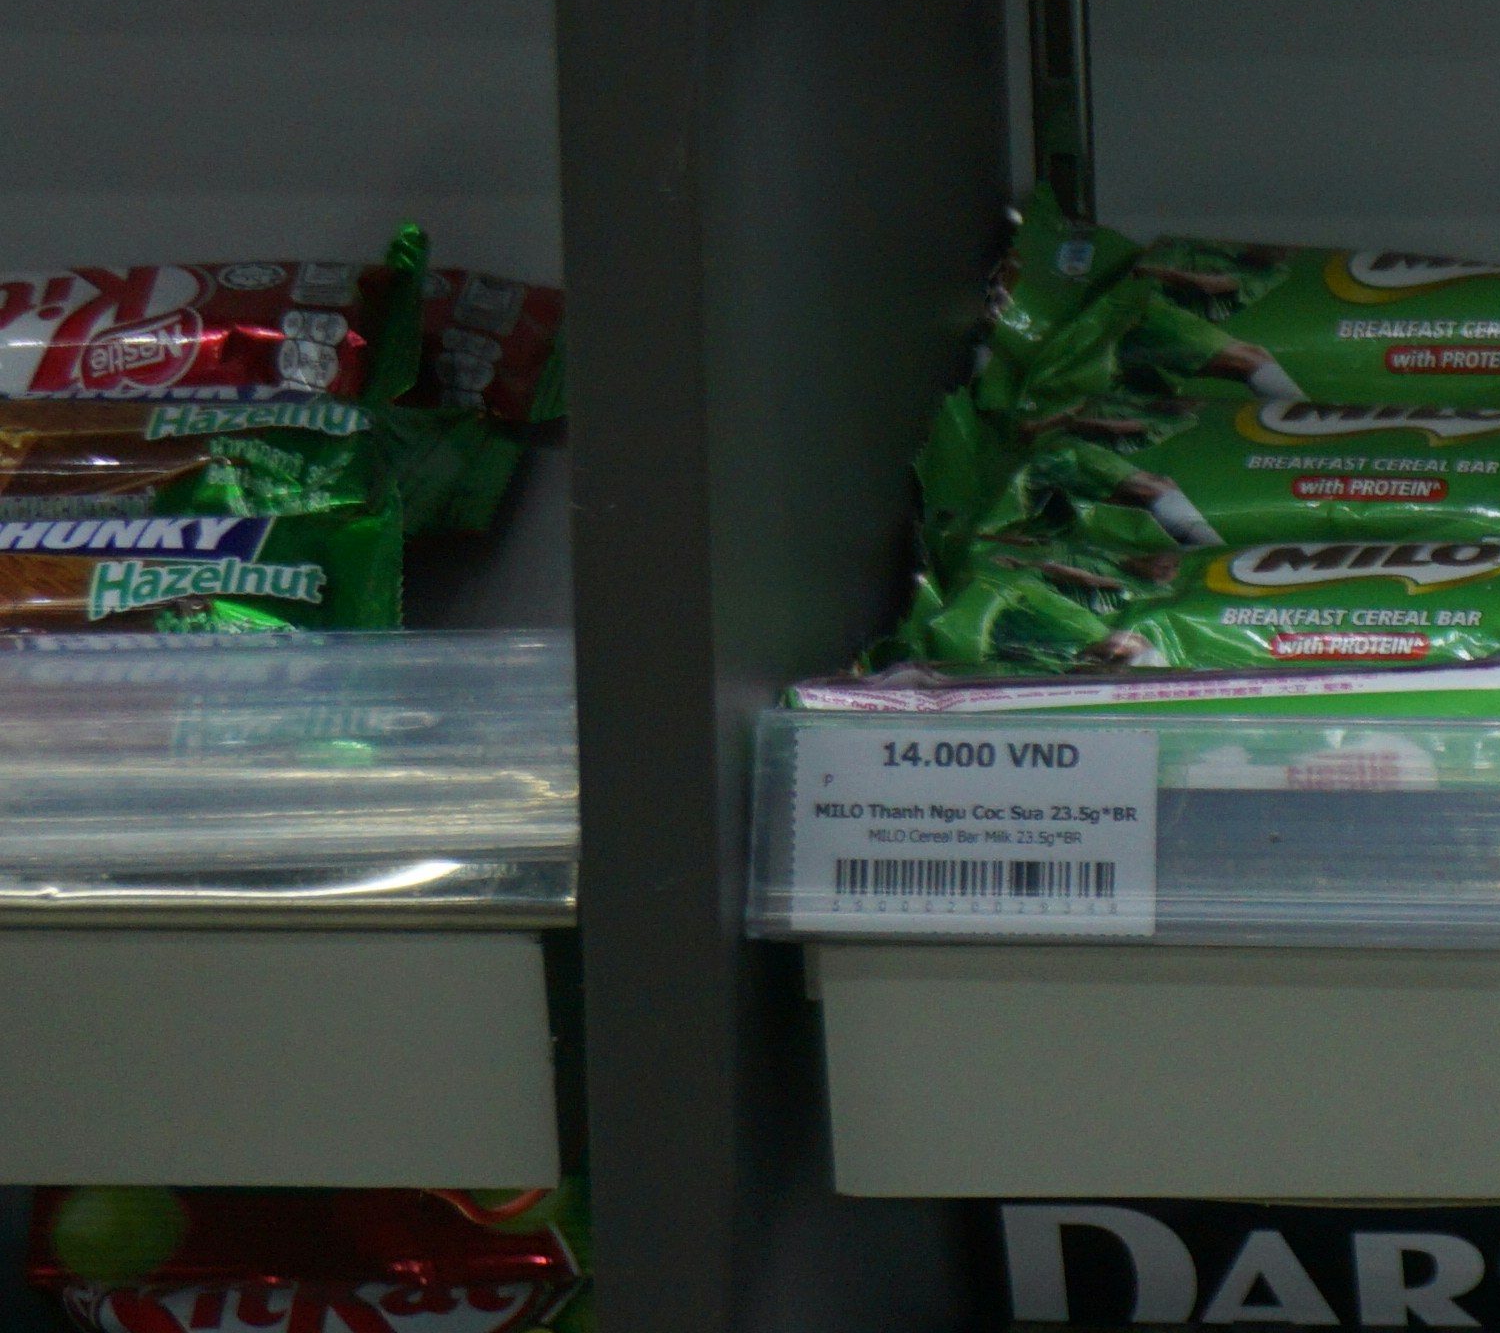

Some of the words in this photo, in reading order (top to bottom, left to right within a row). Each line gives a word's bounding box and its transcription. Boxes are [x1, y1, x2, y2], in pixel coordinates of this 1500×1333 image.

[89, 558, 328, 621] Hazelnut
[1222, 607, 1348, 627] BREAKFAST
[1352, 608, 1432, 627] CEREAL
[1440, 608, 1483, 628] BAR
[883, 741, 995, 767] 14.000
[1007, 743, 1080, 768] VND
[815, 804, 864, 820] MILO
[869, 803, 925, 820] Thanh
[929, 804, 967, 824] Ngu
[971, 805, 1006, 821] Coc
[1010, 806, 1044, 821] Sua
